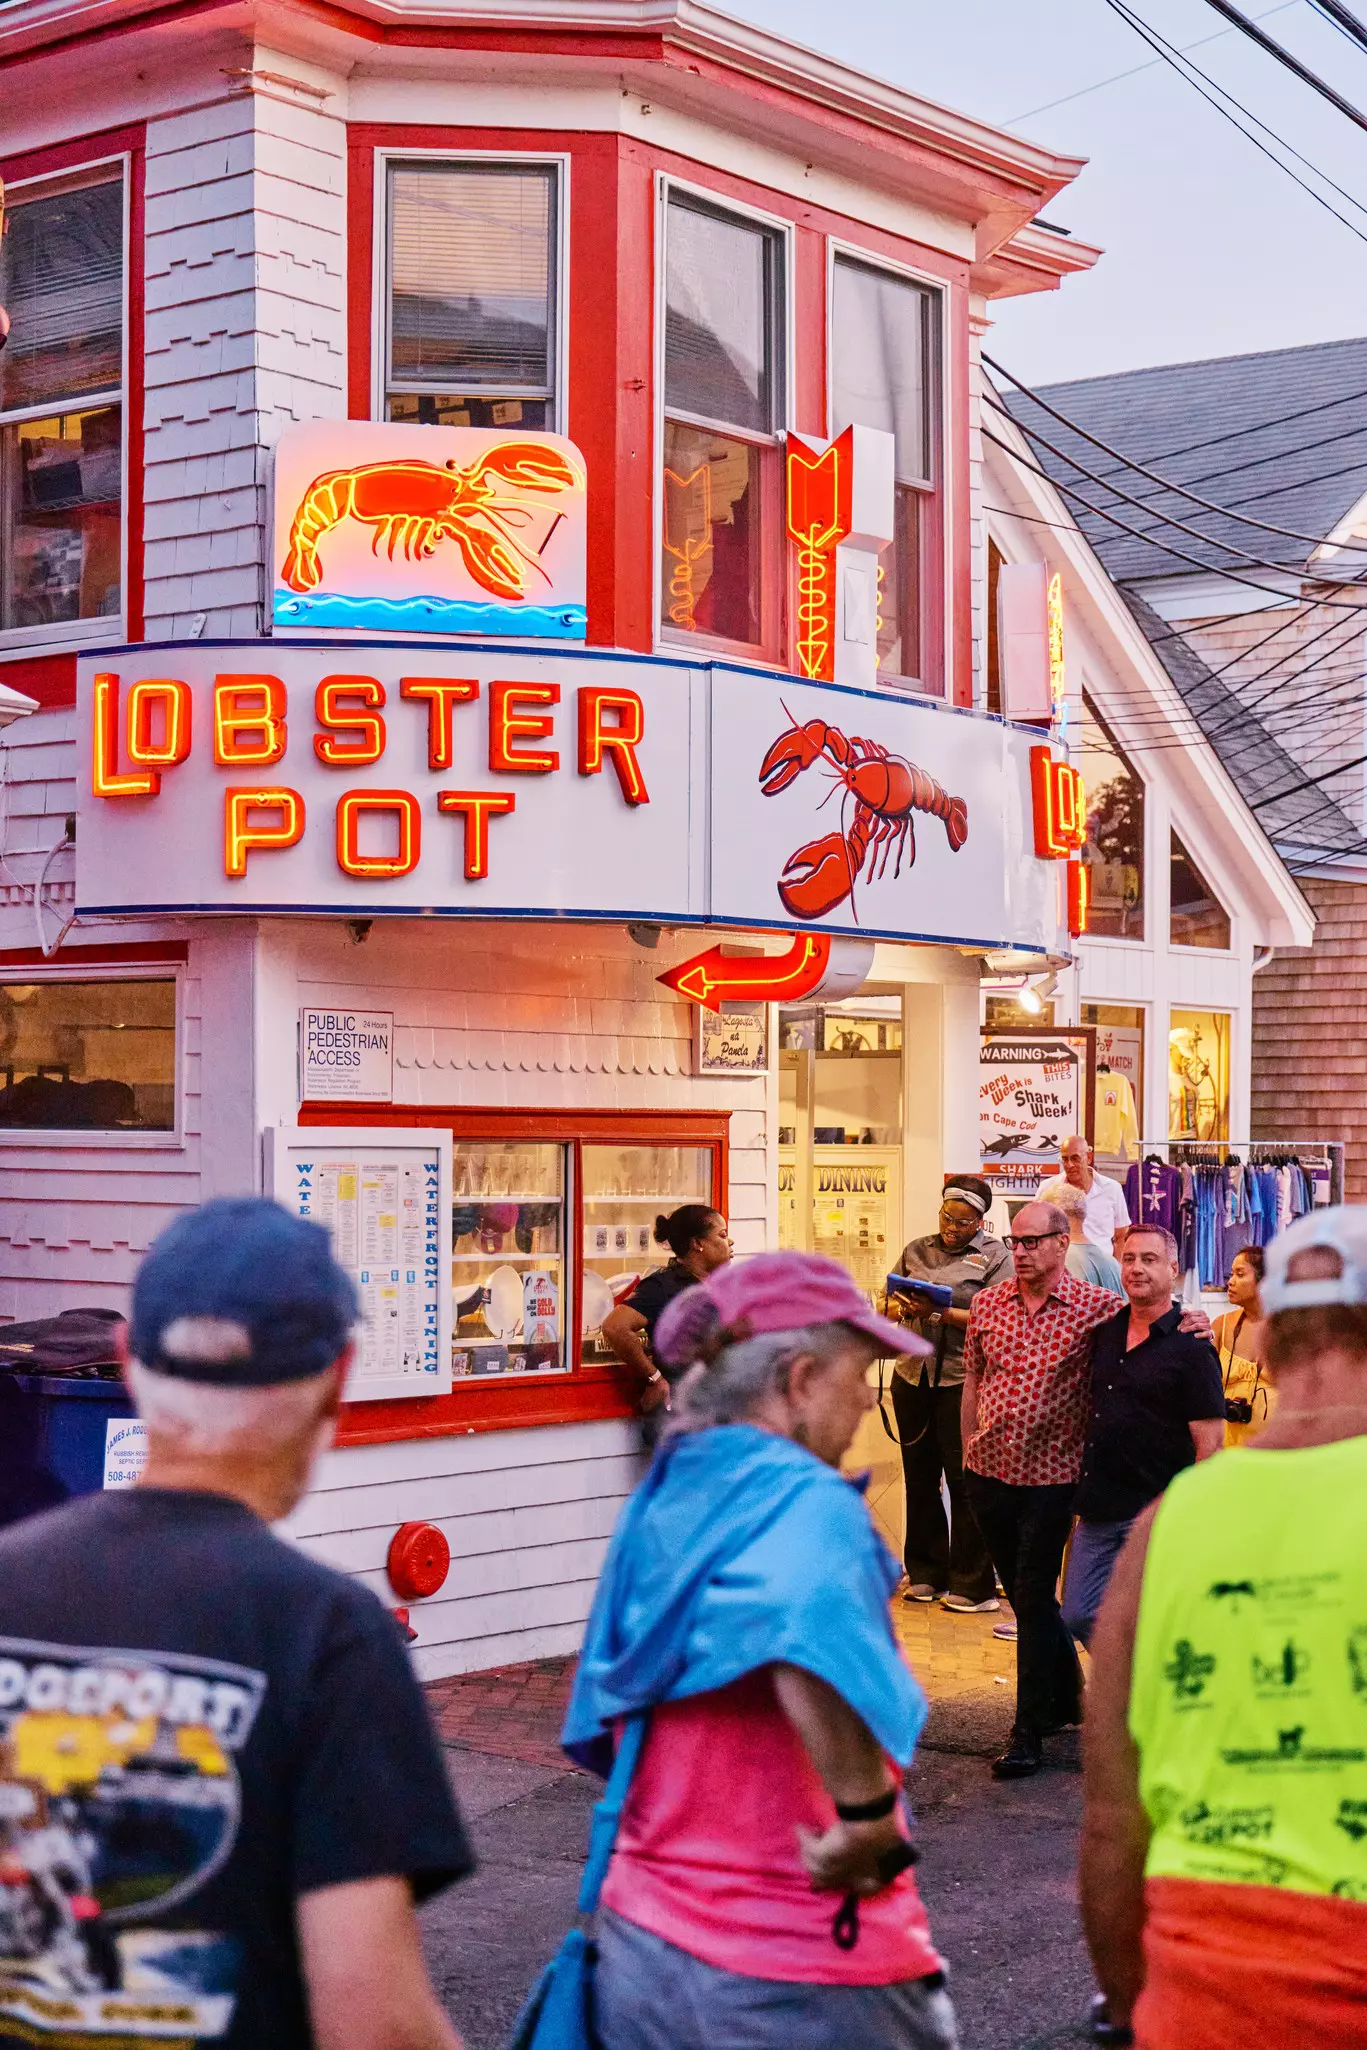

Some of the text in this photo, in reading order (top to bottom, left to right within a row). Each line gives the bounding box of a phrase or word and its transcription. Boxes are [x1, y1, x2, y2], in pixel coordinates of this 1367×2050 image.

[93, 673, 649, 804] LOBSTER
[225, 786, 515, 879] POT
[308, 1014, 356, 1031] PUBLIC
[372, 1021, 388, 1029] Hours
[308, 1032, 388, 1050] PEDESTRIAN
[730, 1033, 739, 1041] na
[308, 1050, 361, 1066] ACCESS
[980, 1047, 1042, 1060] WARNING
[1107, 1055, 1133, 1069] MATCH
[1045, 1062, 1069, 1073] THIS
[1044, 1071, 1072, 1083] BITES
[991, 1078, 1032, 1106] Week is
[1015, 1090, 1059, 1107] Shark
[1030, 1100, 1072, 1118] Week!
[993, 1113, 1016, 1127] Cape
[1019, 1120, 1037, 1130] Cod
[1000, 1165, 1043, 1174] SHARK
[818, 1167, 887, 1193] DINING
[985, 1177, 1041, 1188] IGHTIN
[424, 1164, 438, 1372] WATERFRONT DINING
[106, 1430, 125, 1454] JAMES
